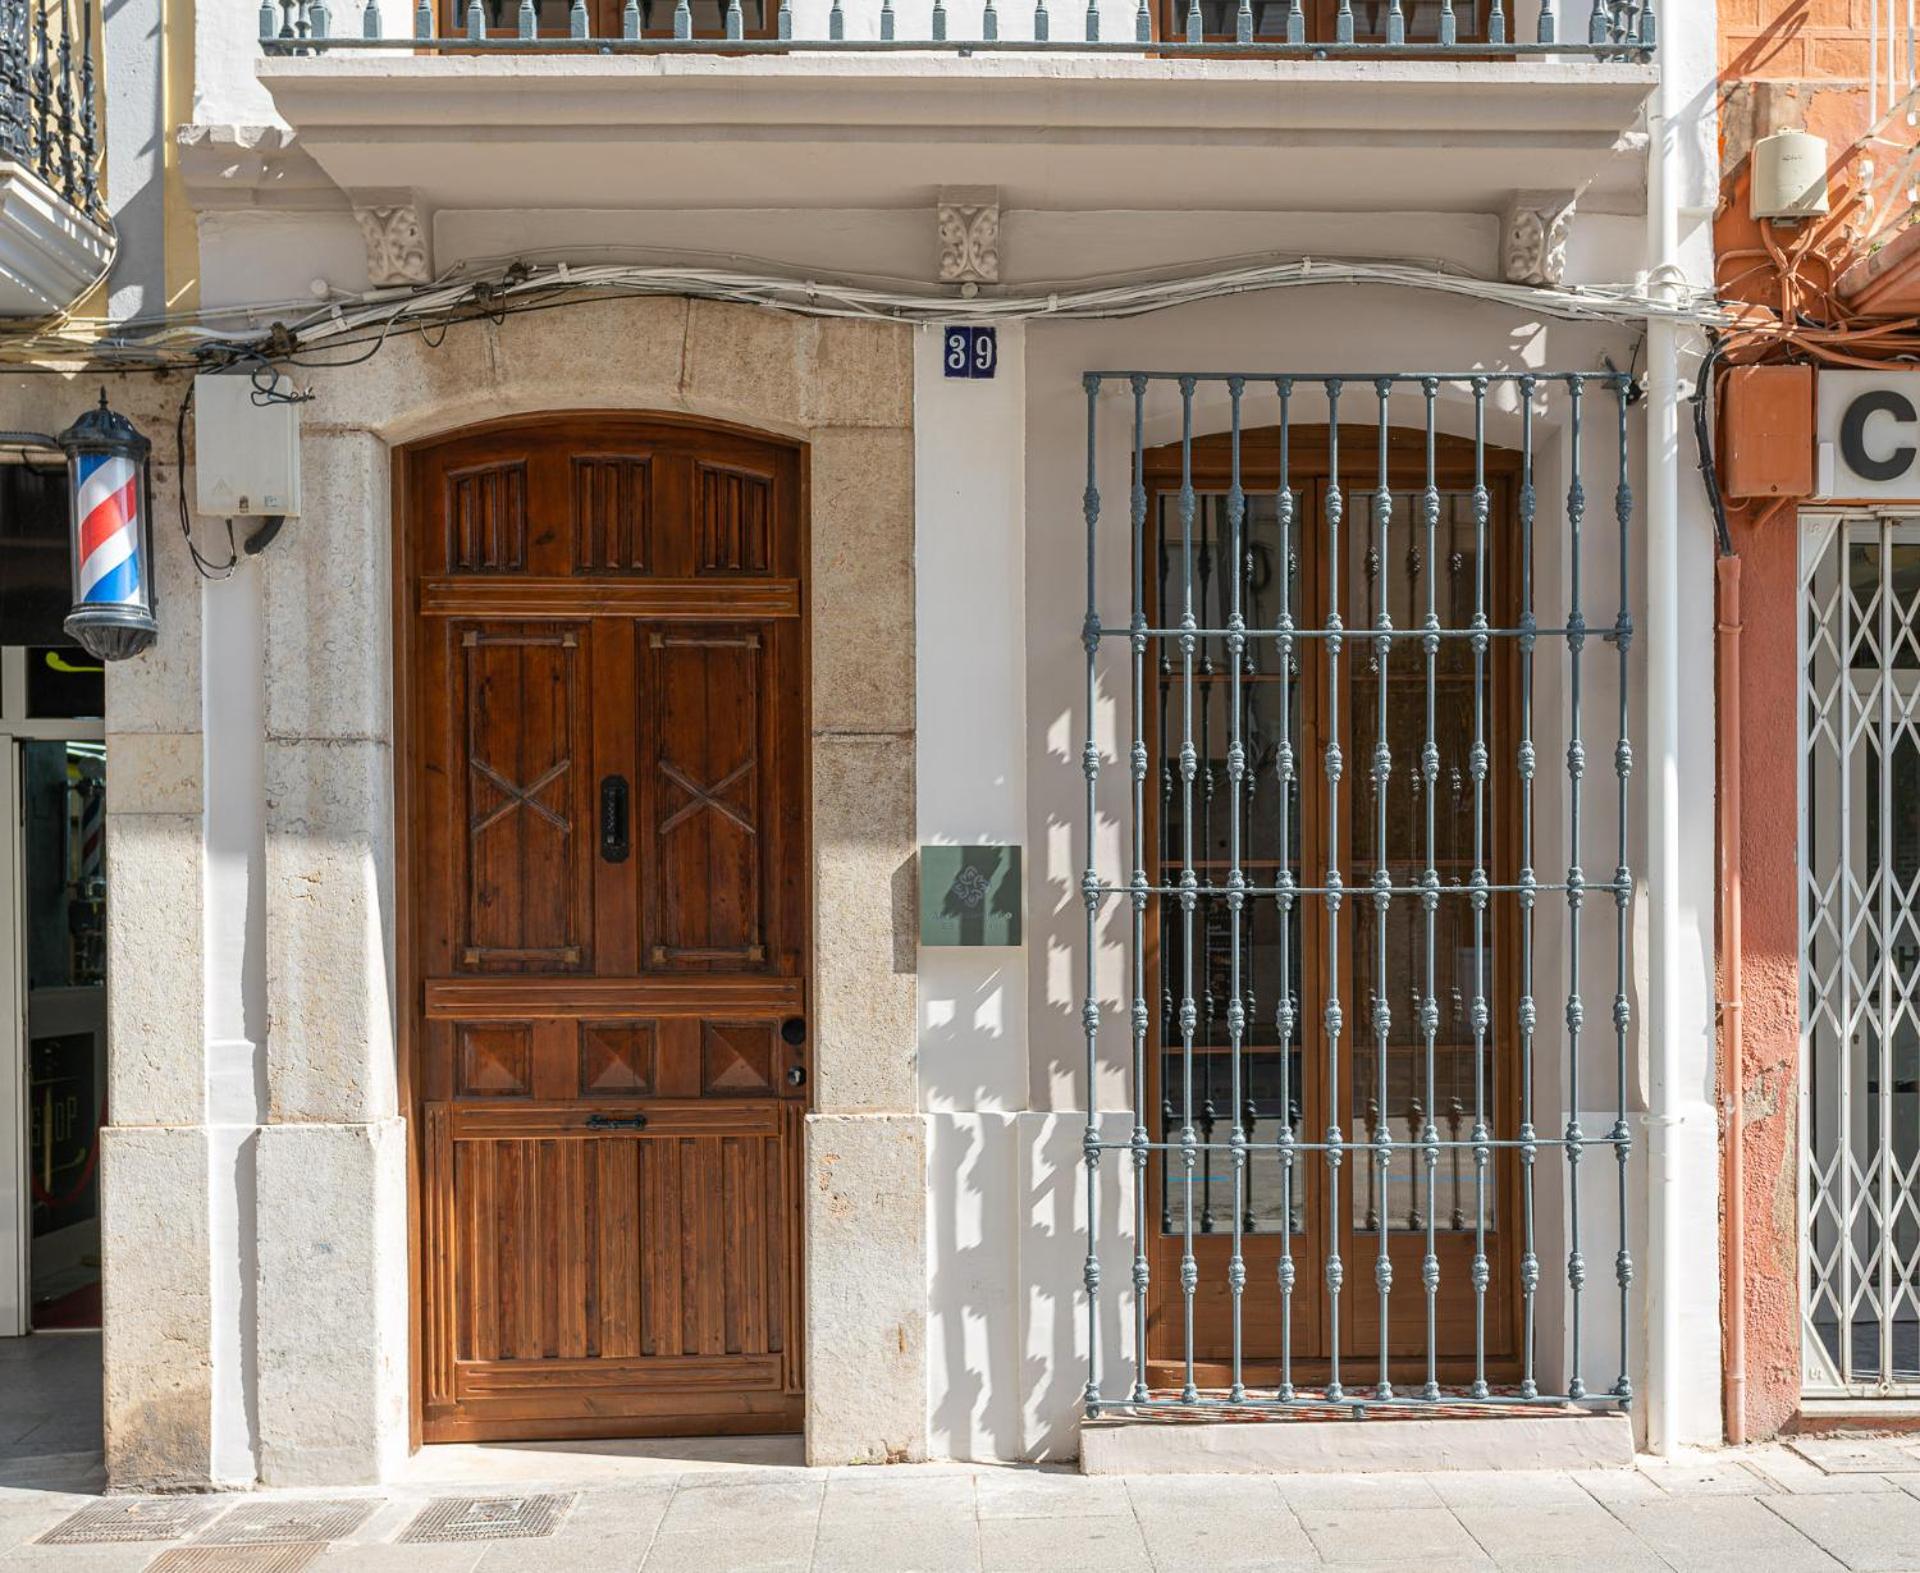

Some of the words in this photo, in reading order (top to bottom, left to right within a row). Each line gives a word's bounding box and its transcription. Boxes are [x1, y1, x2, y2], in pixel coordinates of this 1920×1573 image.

[948, 334, 993, 369] 39
[1840, 389, 1918, 482] C
[31, 1096, 77, 1146] SOP
